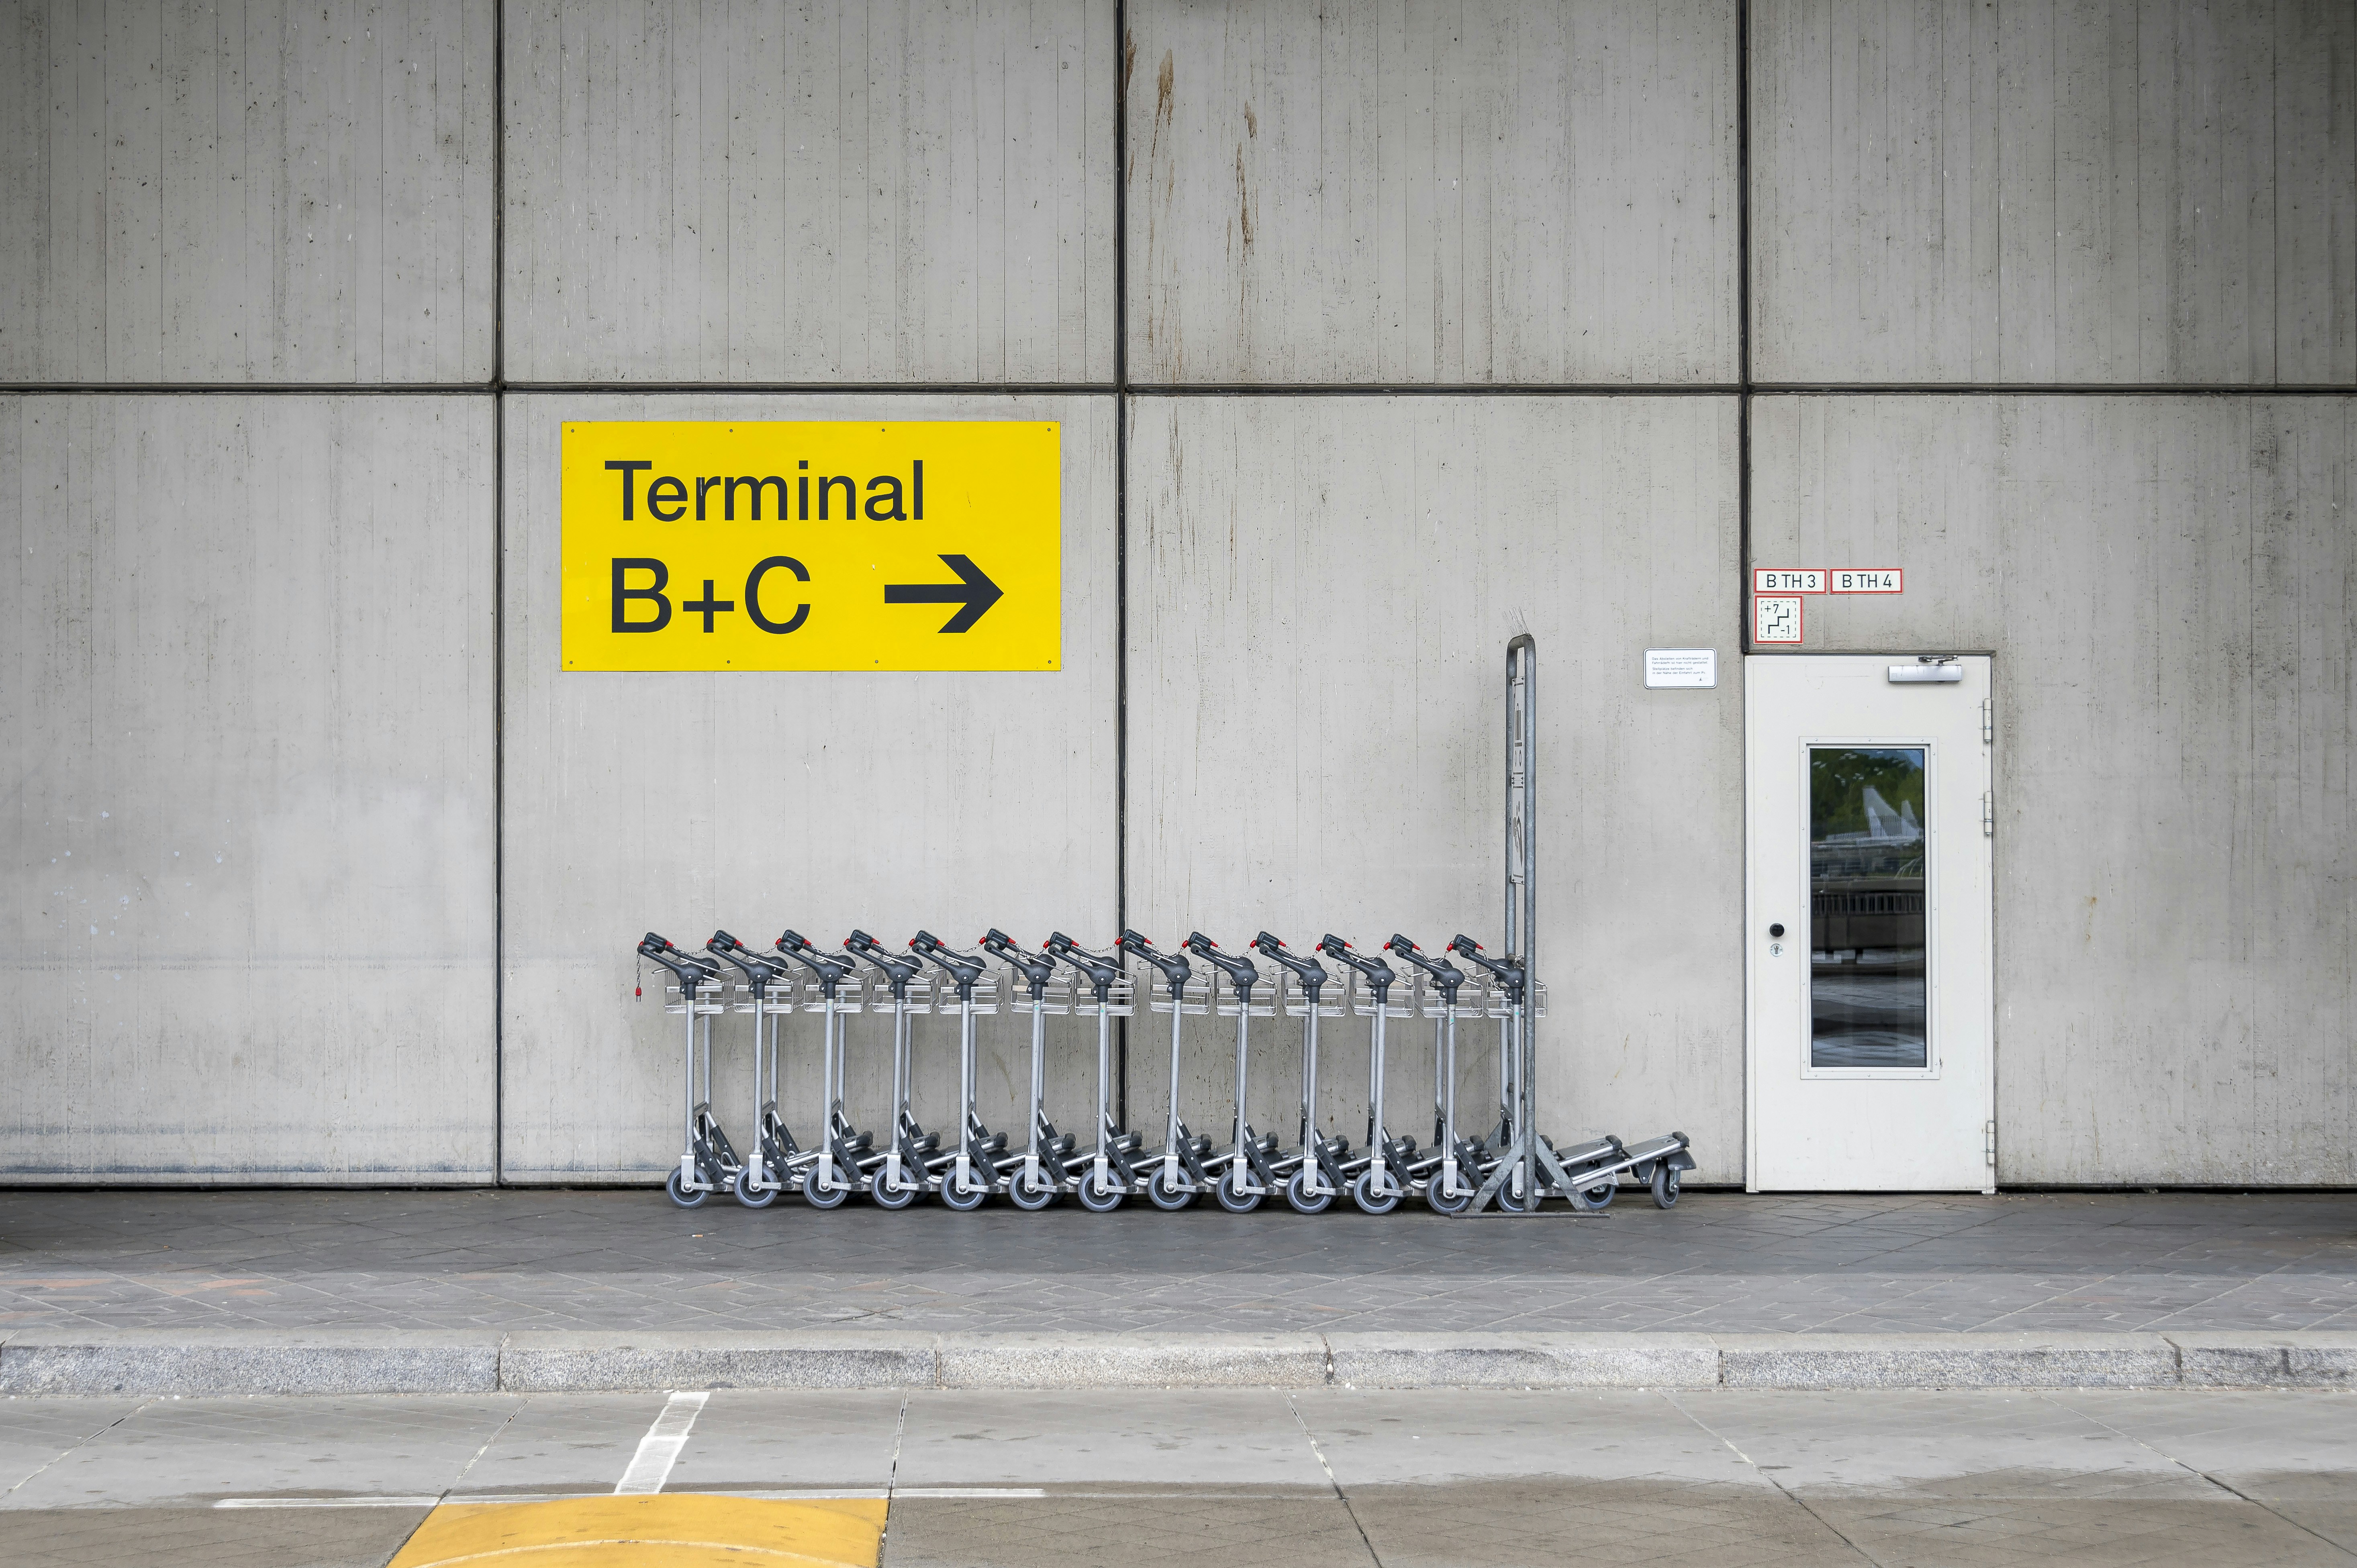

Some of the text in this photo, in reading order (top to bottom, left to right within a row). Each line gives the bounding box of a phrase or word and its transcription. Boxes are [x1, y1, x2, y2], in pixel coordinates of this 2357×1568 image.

[605, 459, 923, 522] Terminal
[611, 555, 811, 635] B+C
[1767, 574, 1816, 588] B TH 3
[1842, 574, 1892, 588] B TH 4
